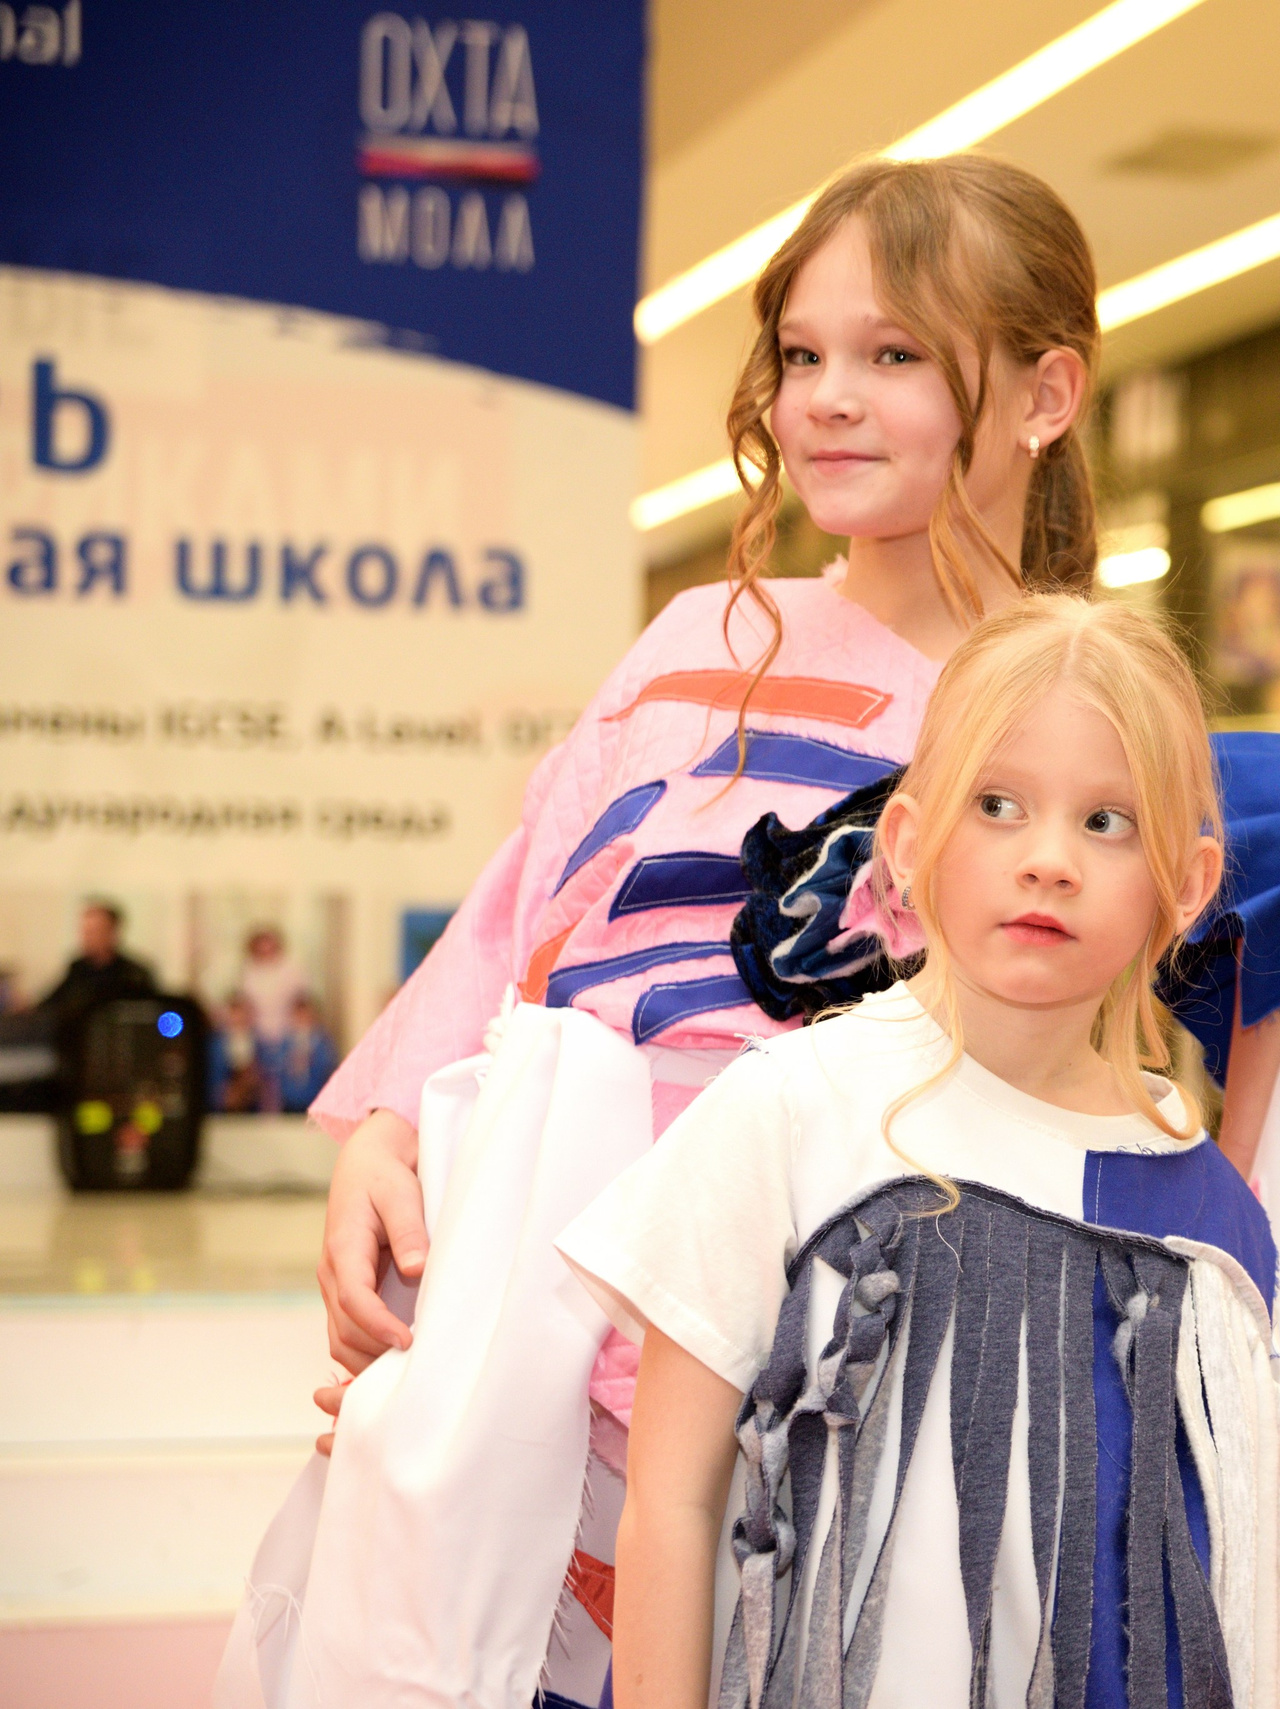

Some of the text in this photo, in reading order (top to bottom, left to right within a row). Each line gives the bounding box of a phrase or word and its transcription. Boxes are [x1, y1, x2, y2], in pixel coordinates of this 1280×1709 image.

[360, 14, 538, 137] ОХТА
[358, 186, 534, 269] МОЛЛ
[173, 536, 527, 615] школа
